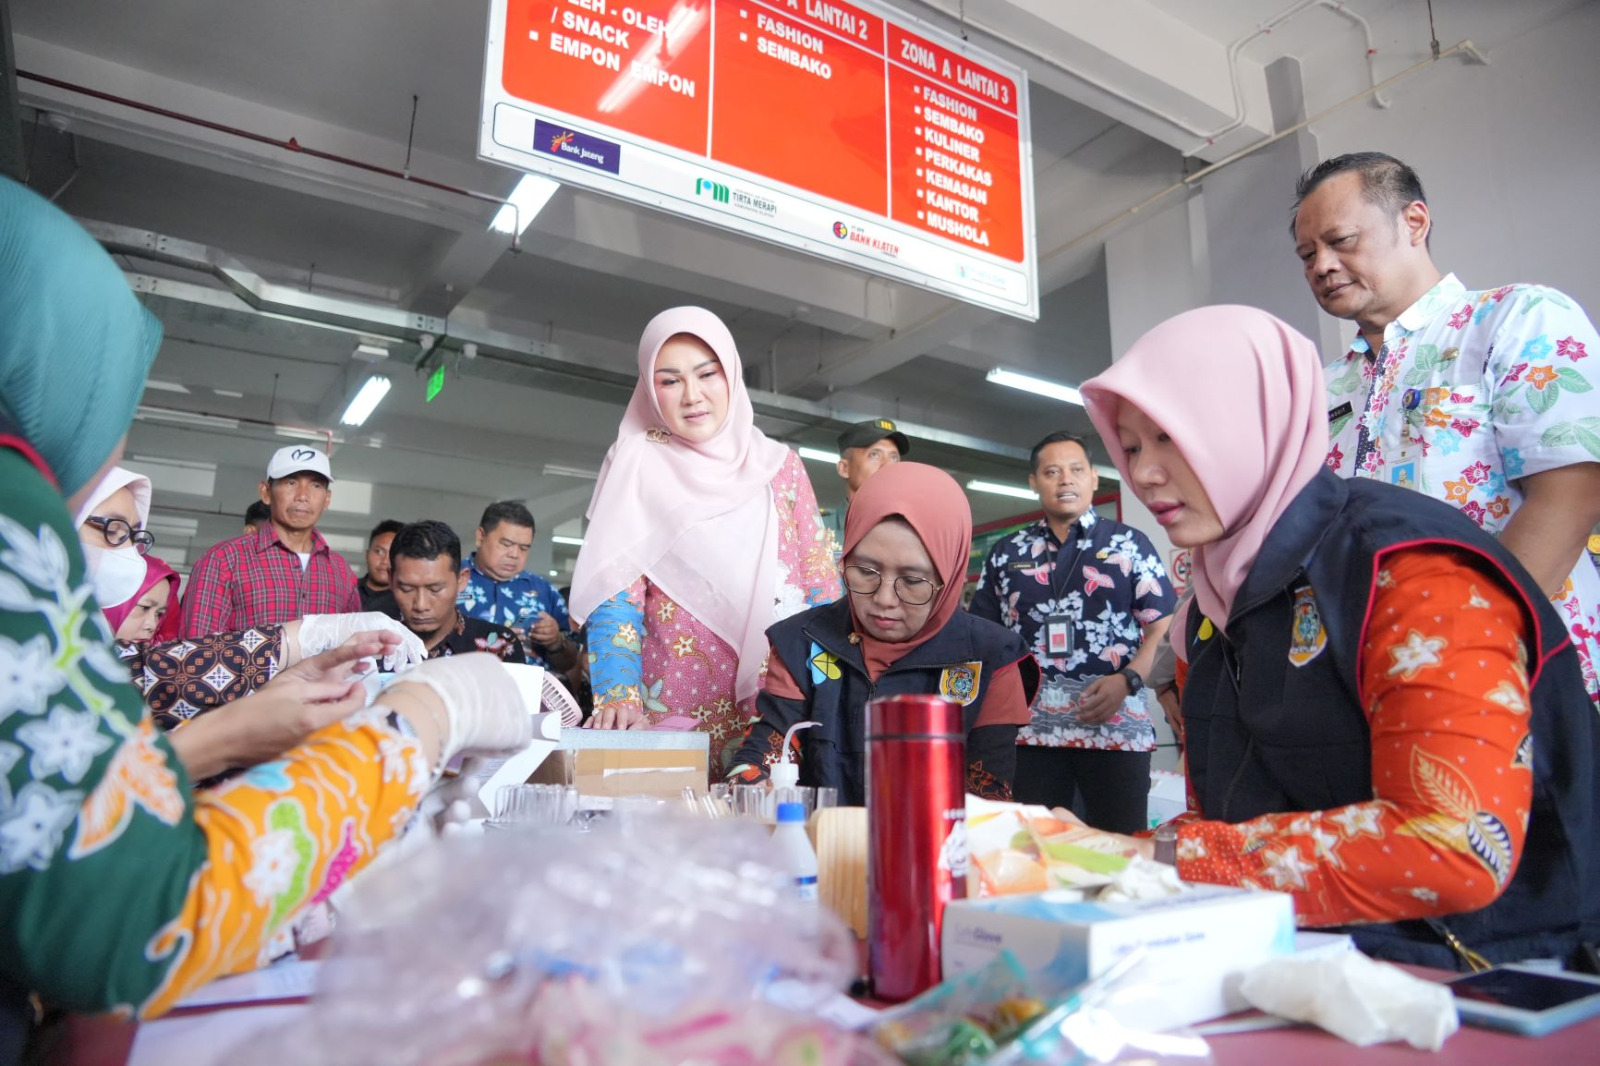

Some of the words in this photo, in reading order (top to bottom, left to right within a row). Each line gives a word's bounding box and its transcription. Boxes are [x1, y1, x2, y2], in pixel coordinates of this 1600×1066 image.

[562, 11, 629, 49] SNACK
[757, 13, 823, 54] FASHION
[805, 0, 855, 35] LANTAI
[859, 19, 868, 40] 2
[550, 32, 620, 71] EMPON
[631, 60, 695, 97] EMPON
[757, 37, 831, 79] SEMBAKO
[901, 39, 936, 72] ZONA
[942, 59, 951, 79] A
[957, 65, 999, 100] LANTAI
[1001, 85, 1009, 104] 3
[923, 86, 977, 122] FASHION
[924, 106, 985, 144] SEMBAKO
[560, 141, 580, 155] Bank
[580, 148, 604, 164] Jateng
[924, 126, 980, 163] KULINER
[925, 147, 992, 187] PERKAKAS
[733, 192, 751, 206] TIRTA
[753, 198, 777, 213] MERAPI
[926, 168, 987, 205] KEMASAN
[926, 189, 979, 223] KANTOR
[850, 231, 870, 246] BANK
[872, 238, 899, 254] KLATEN
[927, 210, 990, 247] MUSHOLA
